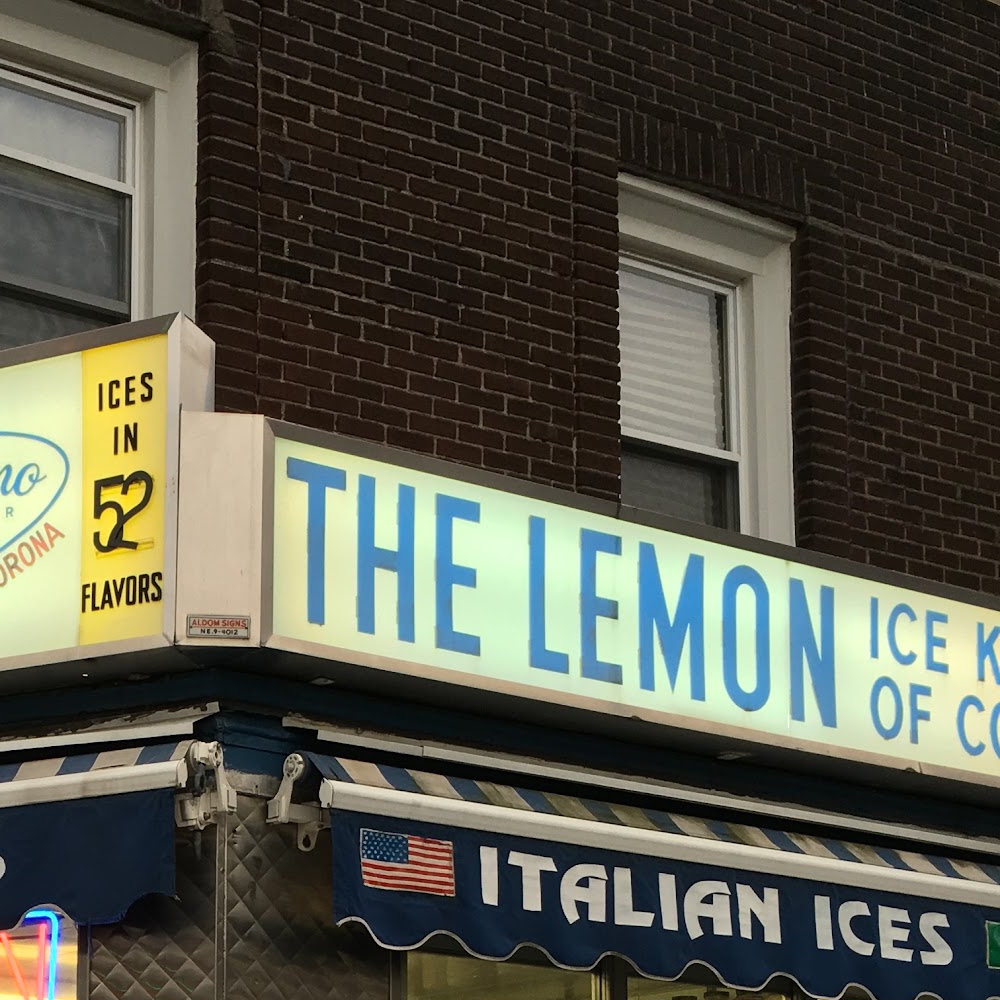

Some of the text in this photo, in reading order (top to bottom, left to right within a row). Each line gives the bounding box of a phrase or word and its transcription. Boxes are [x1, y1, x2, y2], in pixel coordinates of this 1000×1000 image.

[98, 372, 154, 411] ICES
[113, 422, 138, 455] IN
[94, 470, 154, 553] 52
[81, 571, 163, 614] FLAVORS
[192, 619, 247, 627] ALDOM SIGNS
[286, 456, 837, 729] THE LEMON
[870, 596, 949, 674] ICE
[870, 675, 932, 745] OF
[479, 845, 954, 966] ITALIAN ICES
